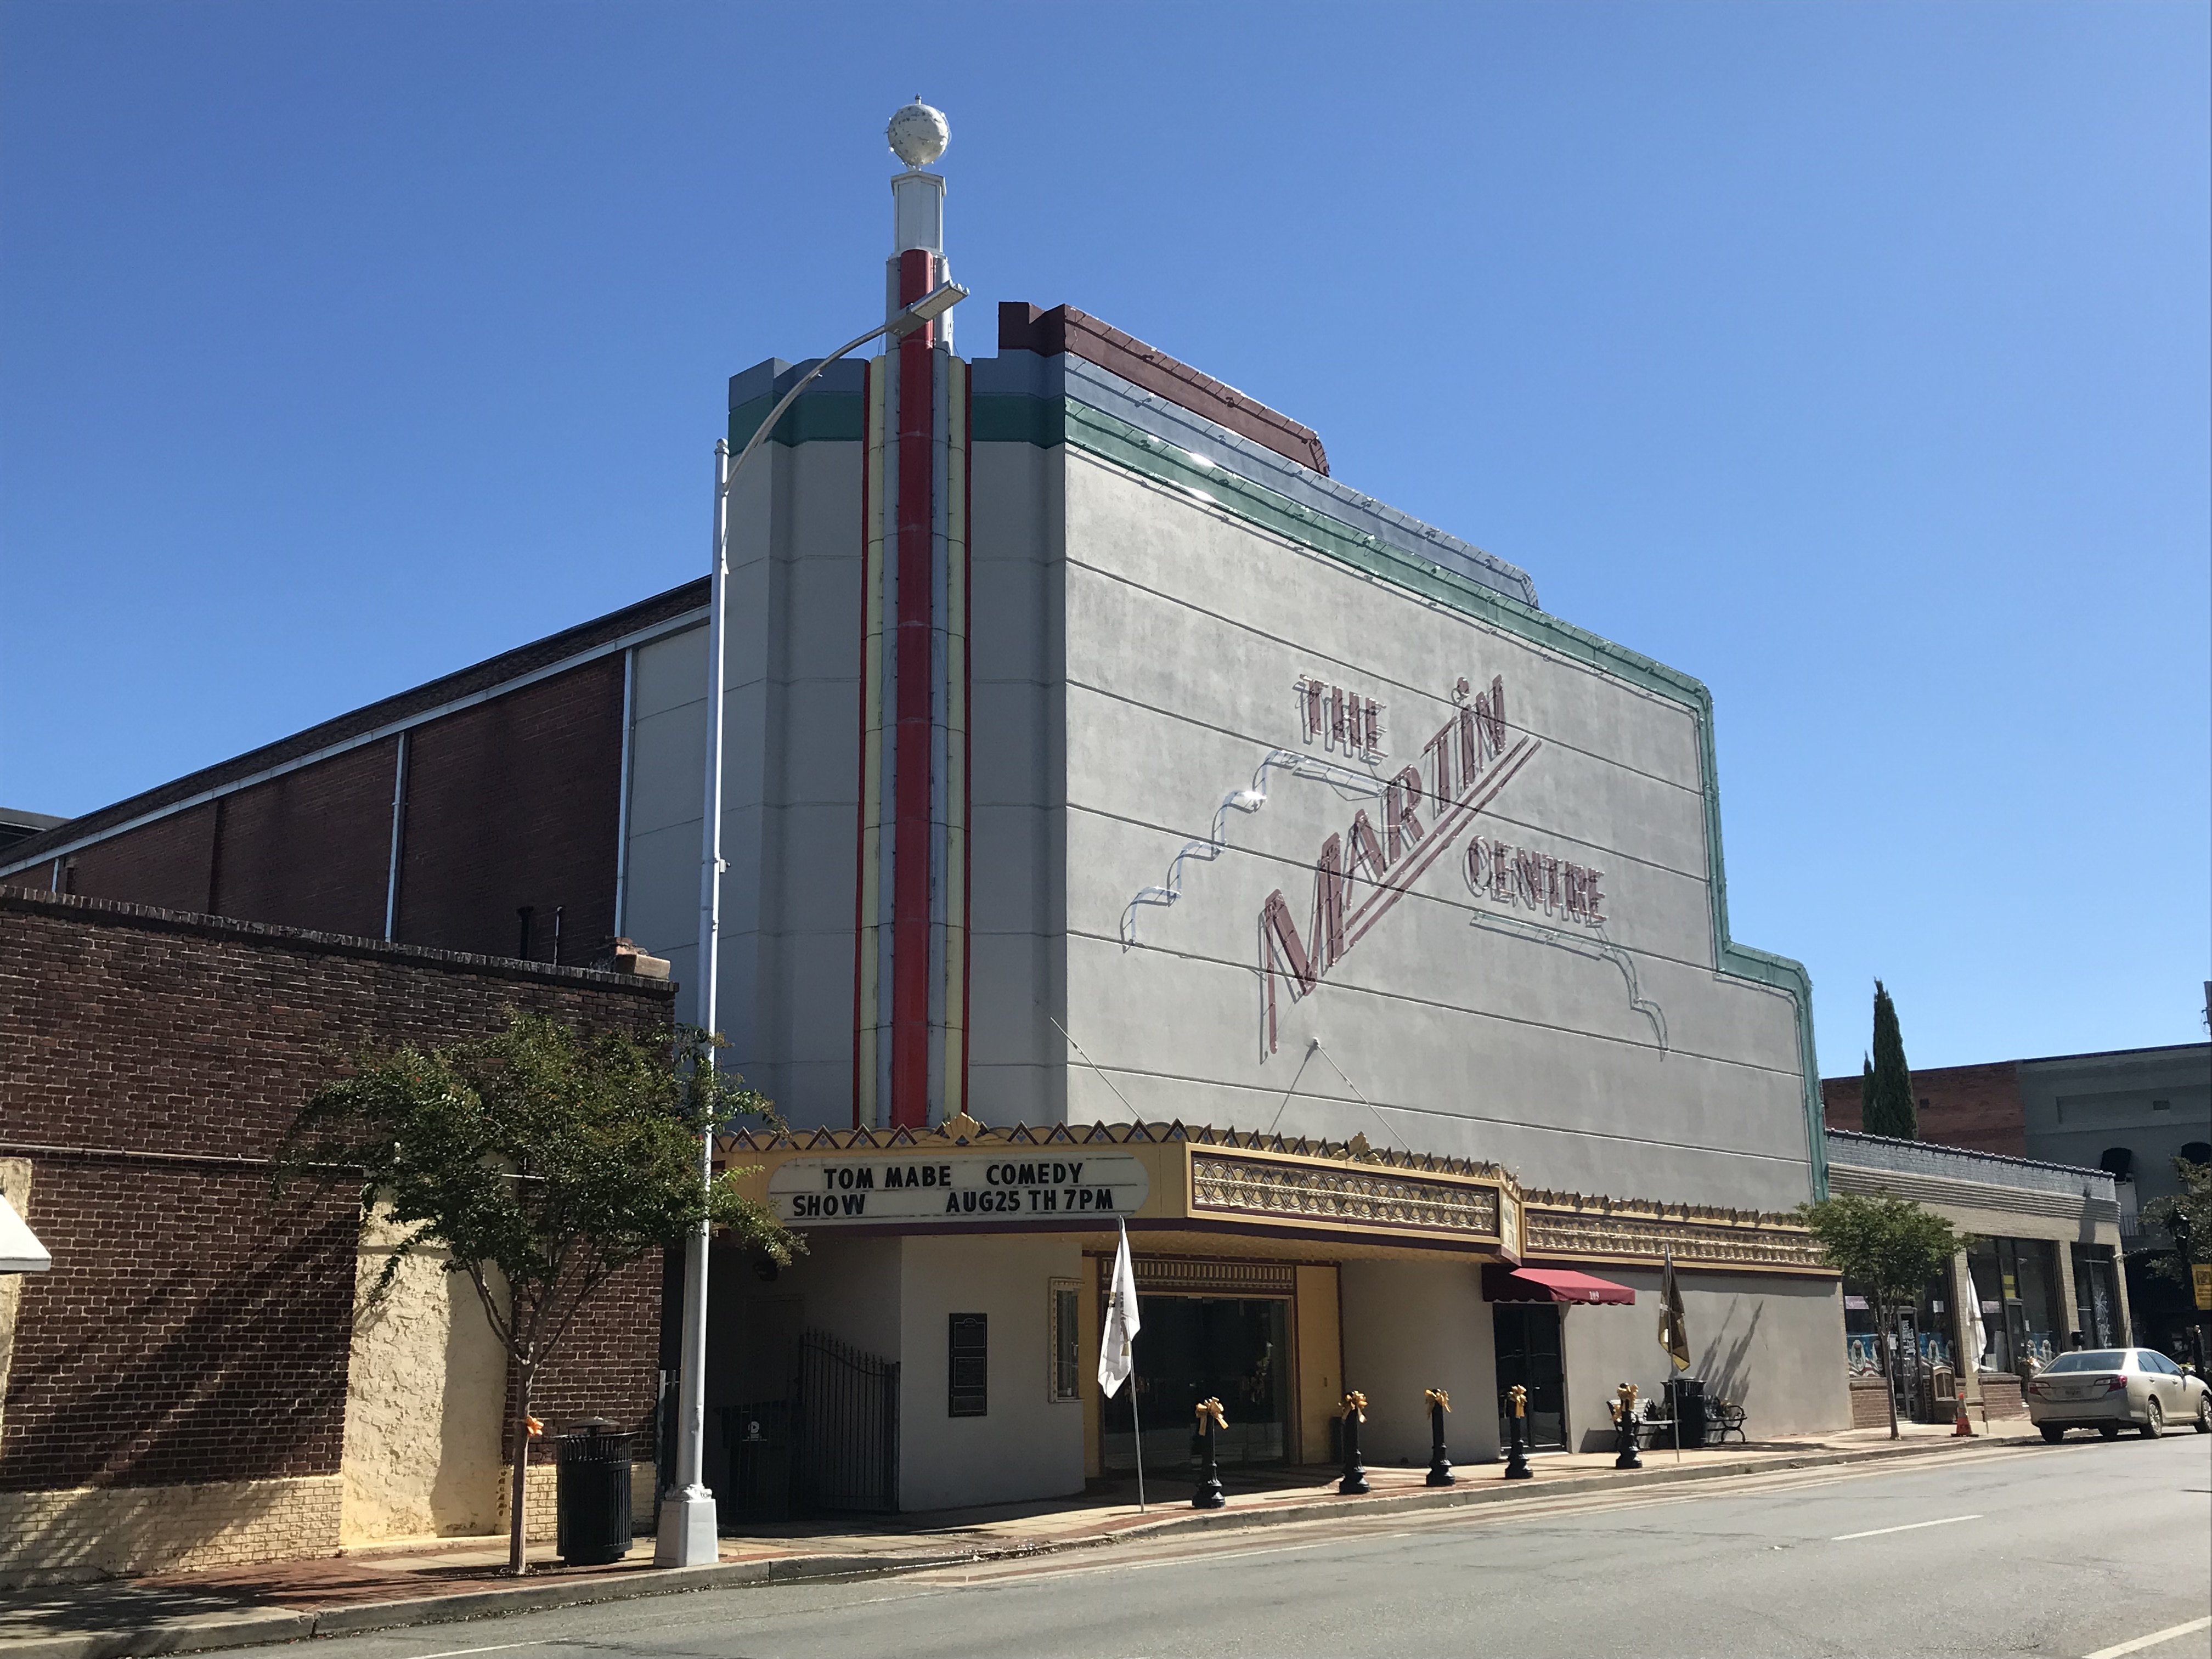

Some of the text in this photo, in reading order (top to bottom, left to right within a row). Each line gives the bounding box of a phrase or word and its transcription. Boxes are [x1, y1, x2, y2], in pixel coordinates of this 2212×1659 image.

[1299, 673, 1390, 758] THE
[1469, 834, 1607, 922] CENTRE
[793, 1194, 866, 1216] SHOW
[1063, 1188, 1114, 1210] 7PM
[823, 1163, 1084, 1189] TOM MABE COMEDY
